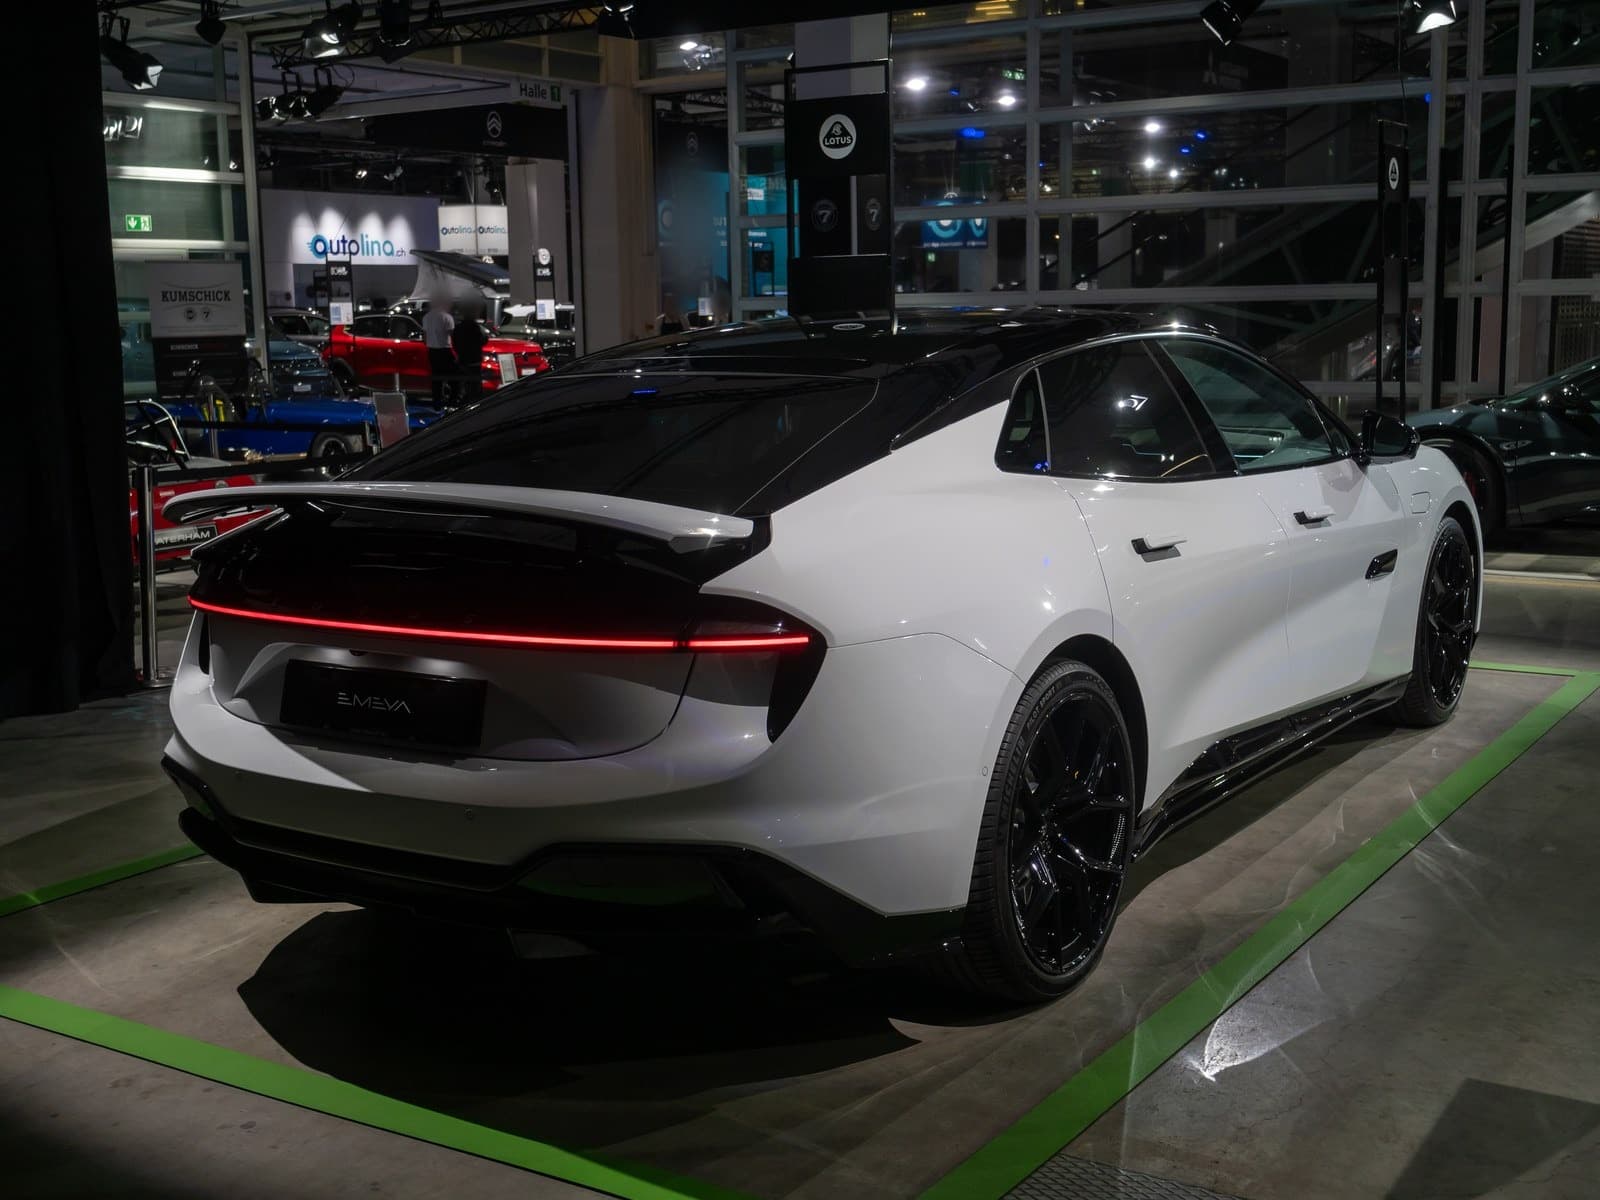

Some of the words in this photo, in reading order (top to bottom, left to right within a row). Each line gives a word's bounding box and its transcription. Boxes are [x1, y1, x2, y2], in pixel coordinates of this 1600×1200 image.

[519, 82, 547, 98] Halle
[824, 135, 852, 146] LOTUS
[817, 209, 831, 223] 7
[161, 290, 231, 303] KUMSCHICK
[154, 530, 210, 545] ATERHAM
[336, 691, 412, 714] EMEYA
